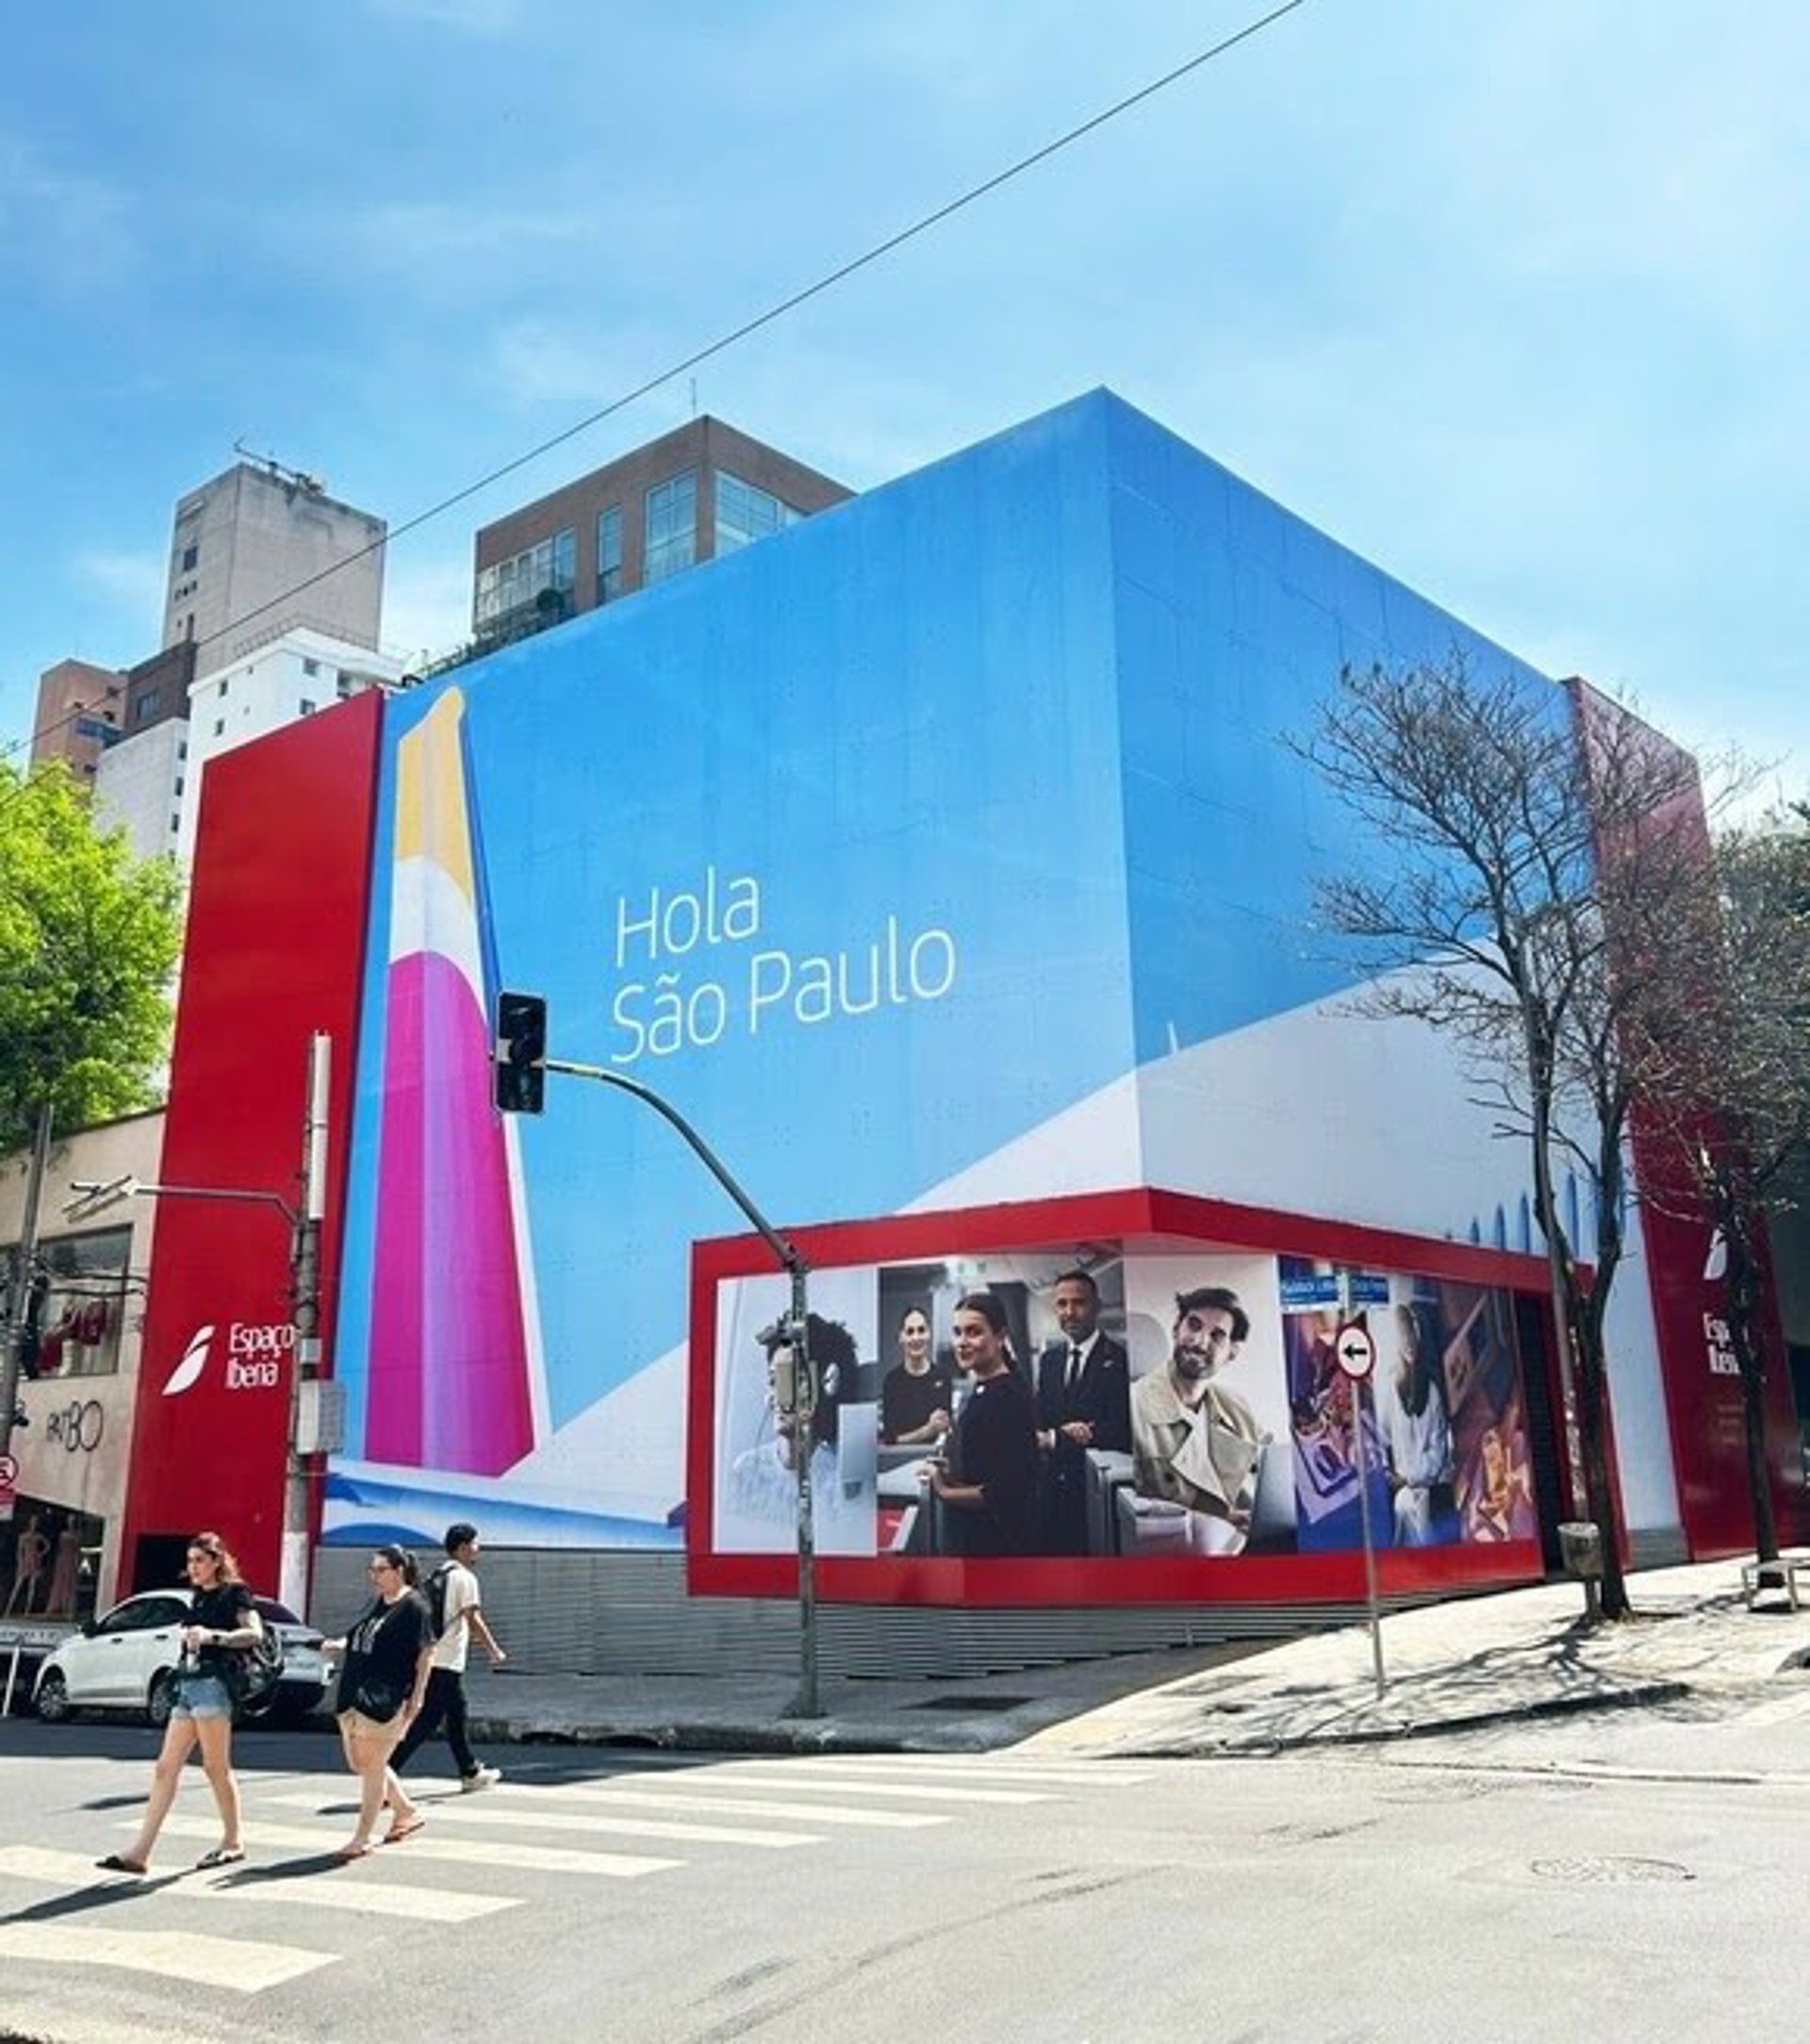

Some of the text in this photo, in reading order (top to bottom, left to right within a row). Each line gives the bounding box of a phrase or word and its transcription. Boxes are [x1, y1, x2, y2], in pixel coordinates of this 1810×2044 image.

[617, 865, 760, 968] Hola
[611, 915, 956, 1063] São Paulo
[230, 1323, 294, 1358] Espaço
